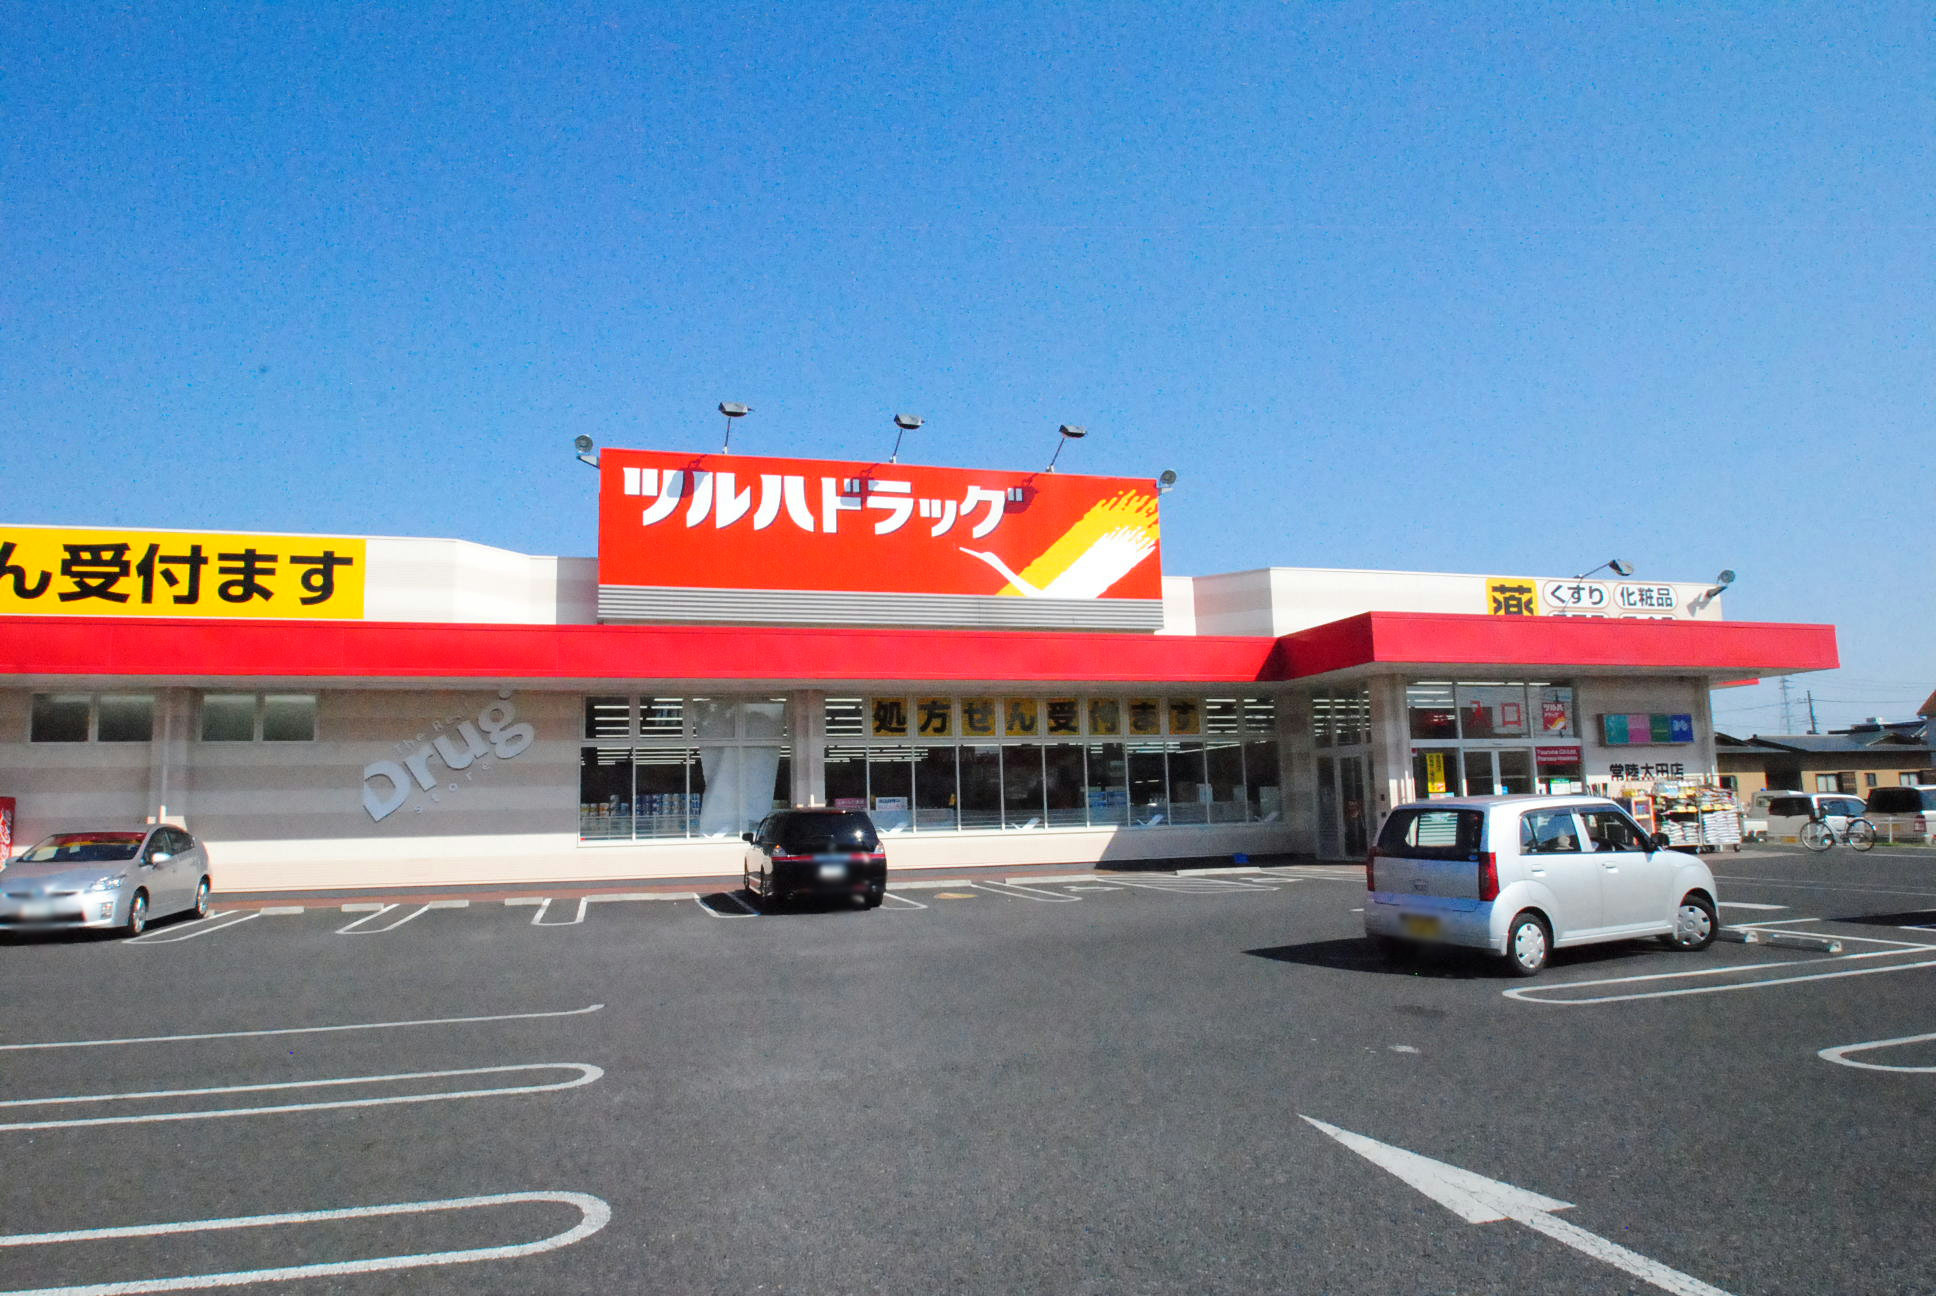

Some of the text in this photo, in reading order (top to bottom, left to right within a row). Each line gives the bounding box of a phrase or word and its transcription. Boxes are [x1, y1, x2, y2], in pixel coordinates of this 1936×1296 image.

[623, 466, 1025, 539] ツルハドラッグ
[1550, 584, 1604, 606] くすり
[1620, 586, 1674, 608] 化粧品
[873, 700, 1197, 733] 処方せん受付ます
[1470, 701, 1522, 728] 入口
[363, 689, 535, 822] Drug
[1609, 762, 1685, 781] 常陸太田店
